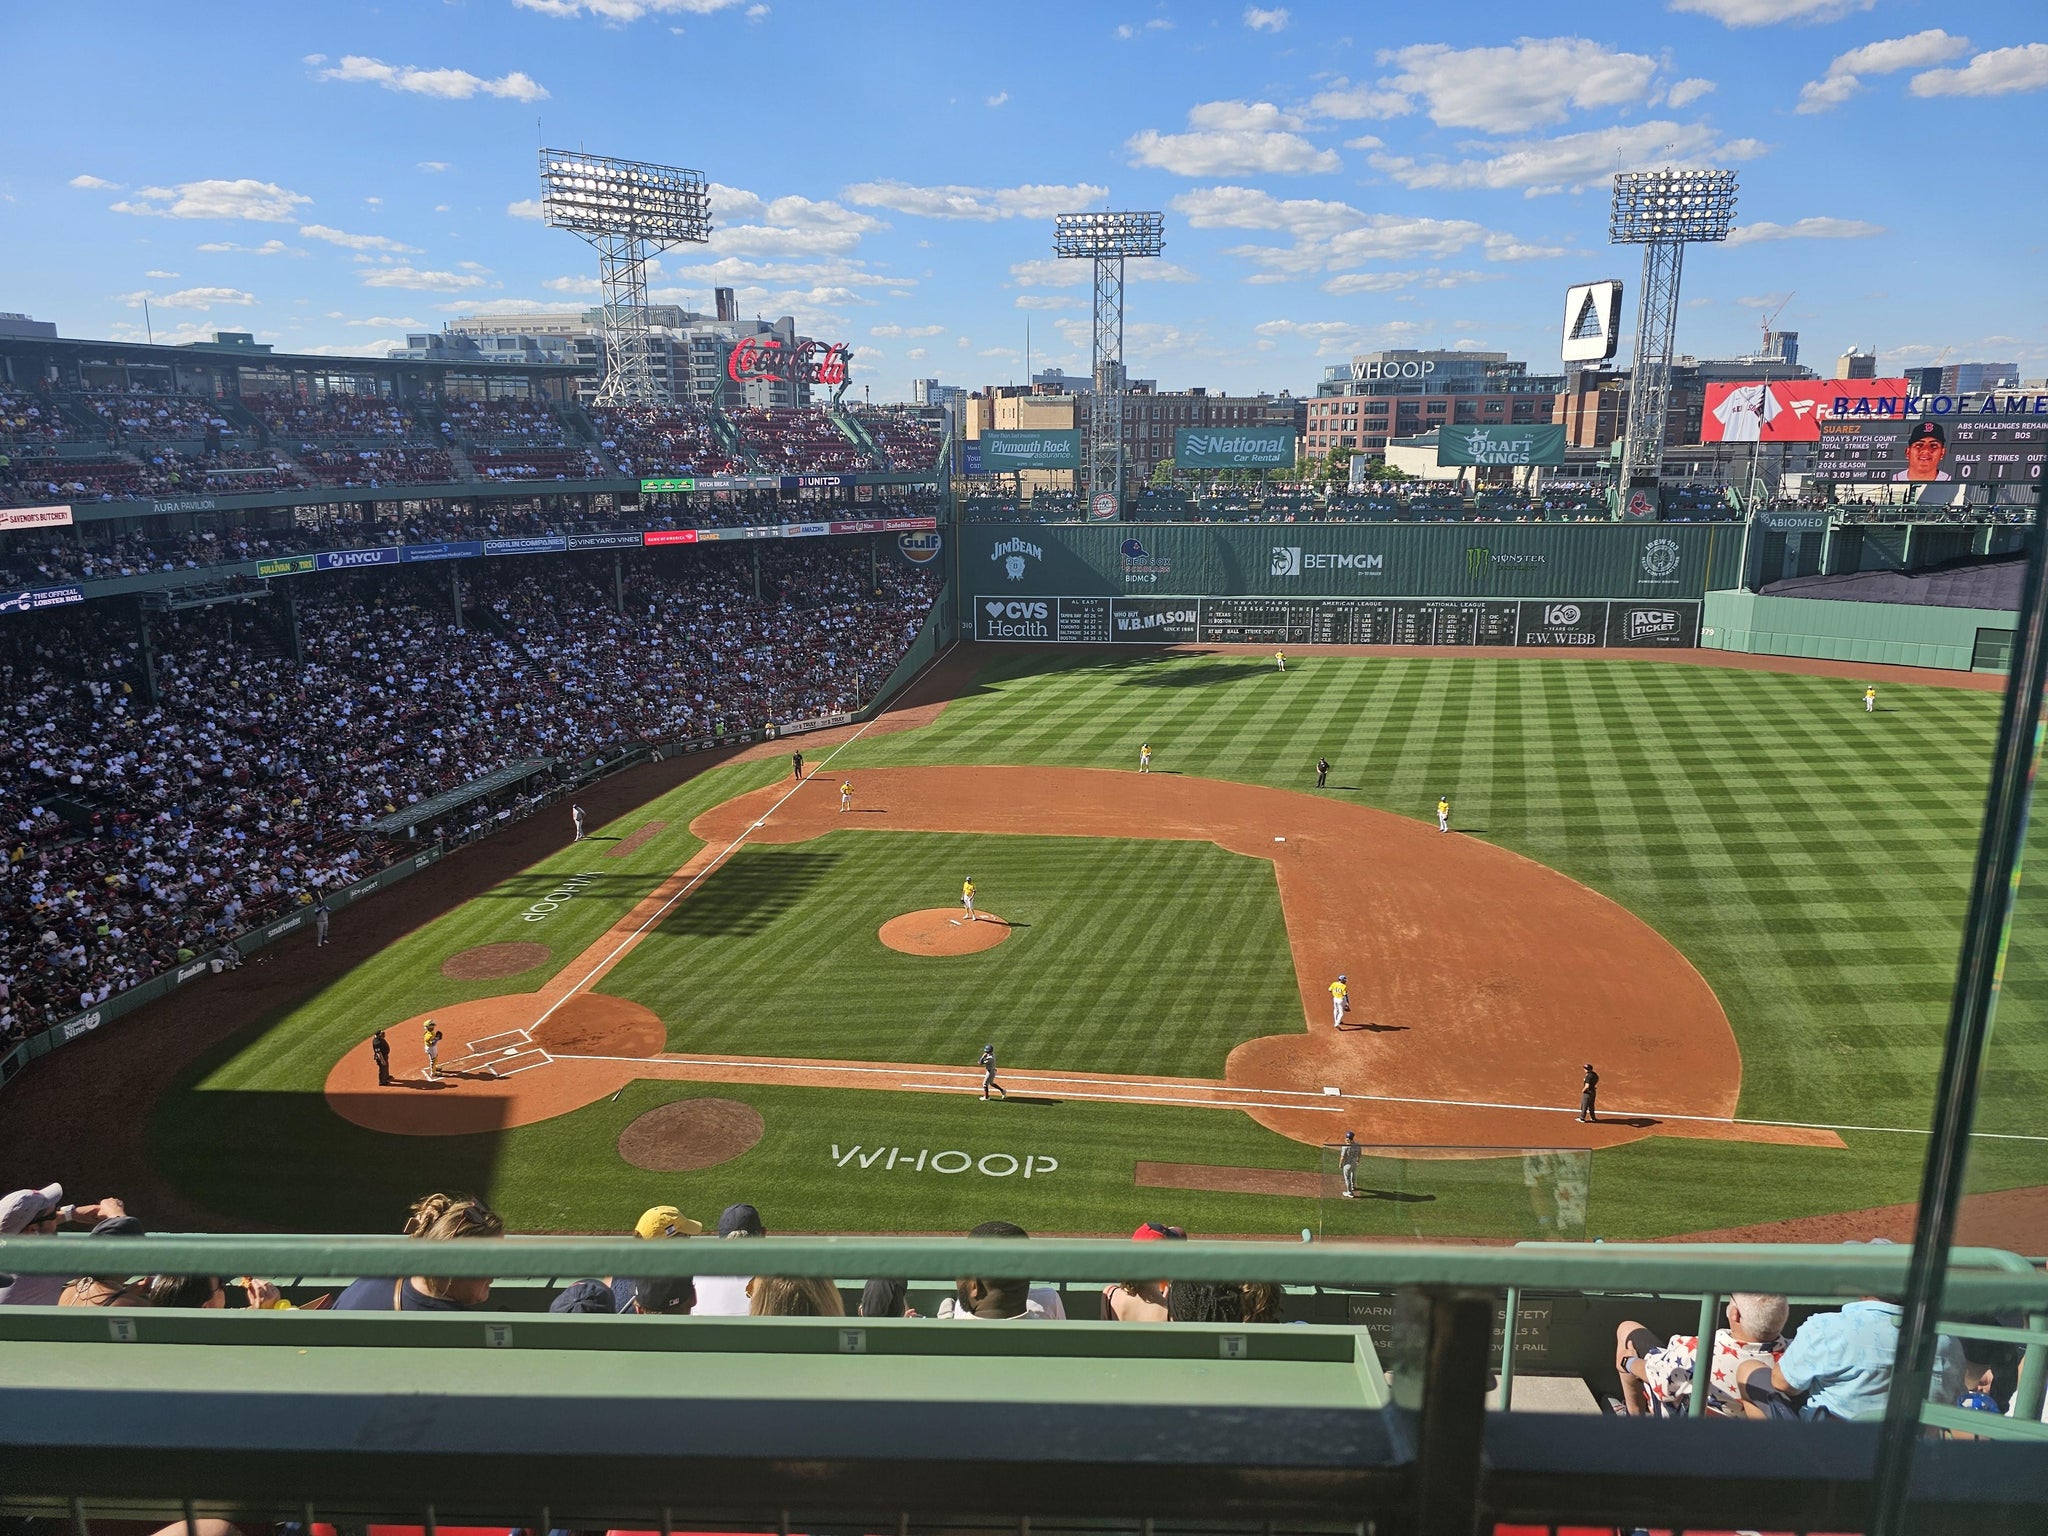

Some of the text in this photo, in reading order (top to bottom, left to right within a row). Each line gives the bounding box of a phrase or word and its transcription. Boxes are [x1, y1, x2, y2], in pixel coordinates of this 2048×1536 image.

[728, 338, 848, 384] Coca-Cola
[1351, 361, 1434, 380] WHOOP
[1834, 396, 1922, 415] BANK
[1932, 396, 1971, 415] OF
[1823, 425, 1861, 434] SUAREZ
[991, 440, 1070, 454] Plymouth Rock
[1208, 436, 1284, 452] National
[1468, 441, 1533, 454] DRAFT
[1475, 452, 1530, 464] KINGS
[1961, 465, 1971, 477] 0
[2031, 465, 2041, 477] 0
[807, 477, 840, 486] UNITED
[181, 500, 215, 510] PAVILION
[1769, 518, 1823, 528] ABIOMED
[486, 541, 520, 549] COGHLIN
[520, 538, 564, 547] COMPANIES
[899, 532, 939, 548] Gulf
[1645, 538, 1680, 551] IBEW 103
[345, 552, 381, 563] HYCU
[1126, 557, 1171, 566] RED SOX
[1304, 554, 1383, 569] BETMGM
[1491, 554, 1546, 563] MONSTER
[260, 561, 313, 575] SULLIVAN TIRE
[1125, 574, 1149, 582] BIDMC
[48, 588, 78, 598] OFFICIAL
[33, 594, 84, 607] LOBSTER ROLL
[1006, 602, 1048, 619] CVS
[1544, 604, 1581, 625] 160
[1635, 611, 1675, 625] ACE
[988, 620, 1048, 637] Health
[1635, 623, 1674, 633] TICKET
[1526, 633, 1596, 645] F.W. WEBB
[521, 871, 605, 922] WHOOP
[267, 917, 301, 938] smartwater
[177, 961, 207, 984] Franklin
[63, 1016, 86, 1033] Ninety
[64, 1024, 86, 1040] Nine
[831, 1144, 1058, 1179] WHOOP
[1498, 1310, 1549, 1319] SFETY
[1493, 1327, 1528, 1336] BALS
[1523, 1343, 1548, 1351] RAIL
